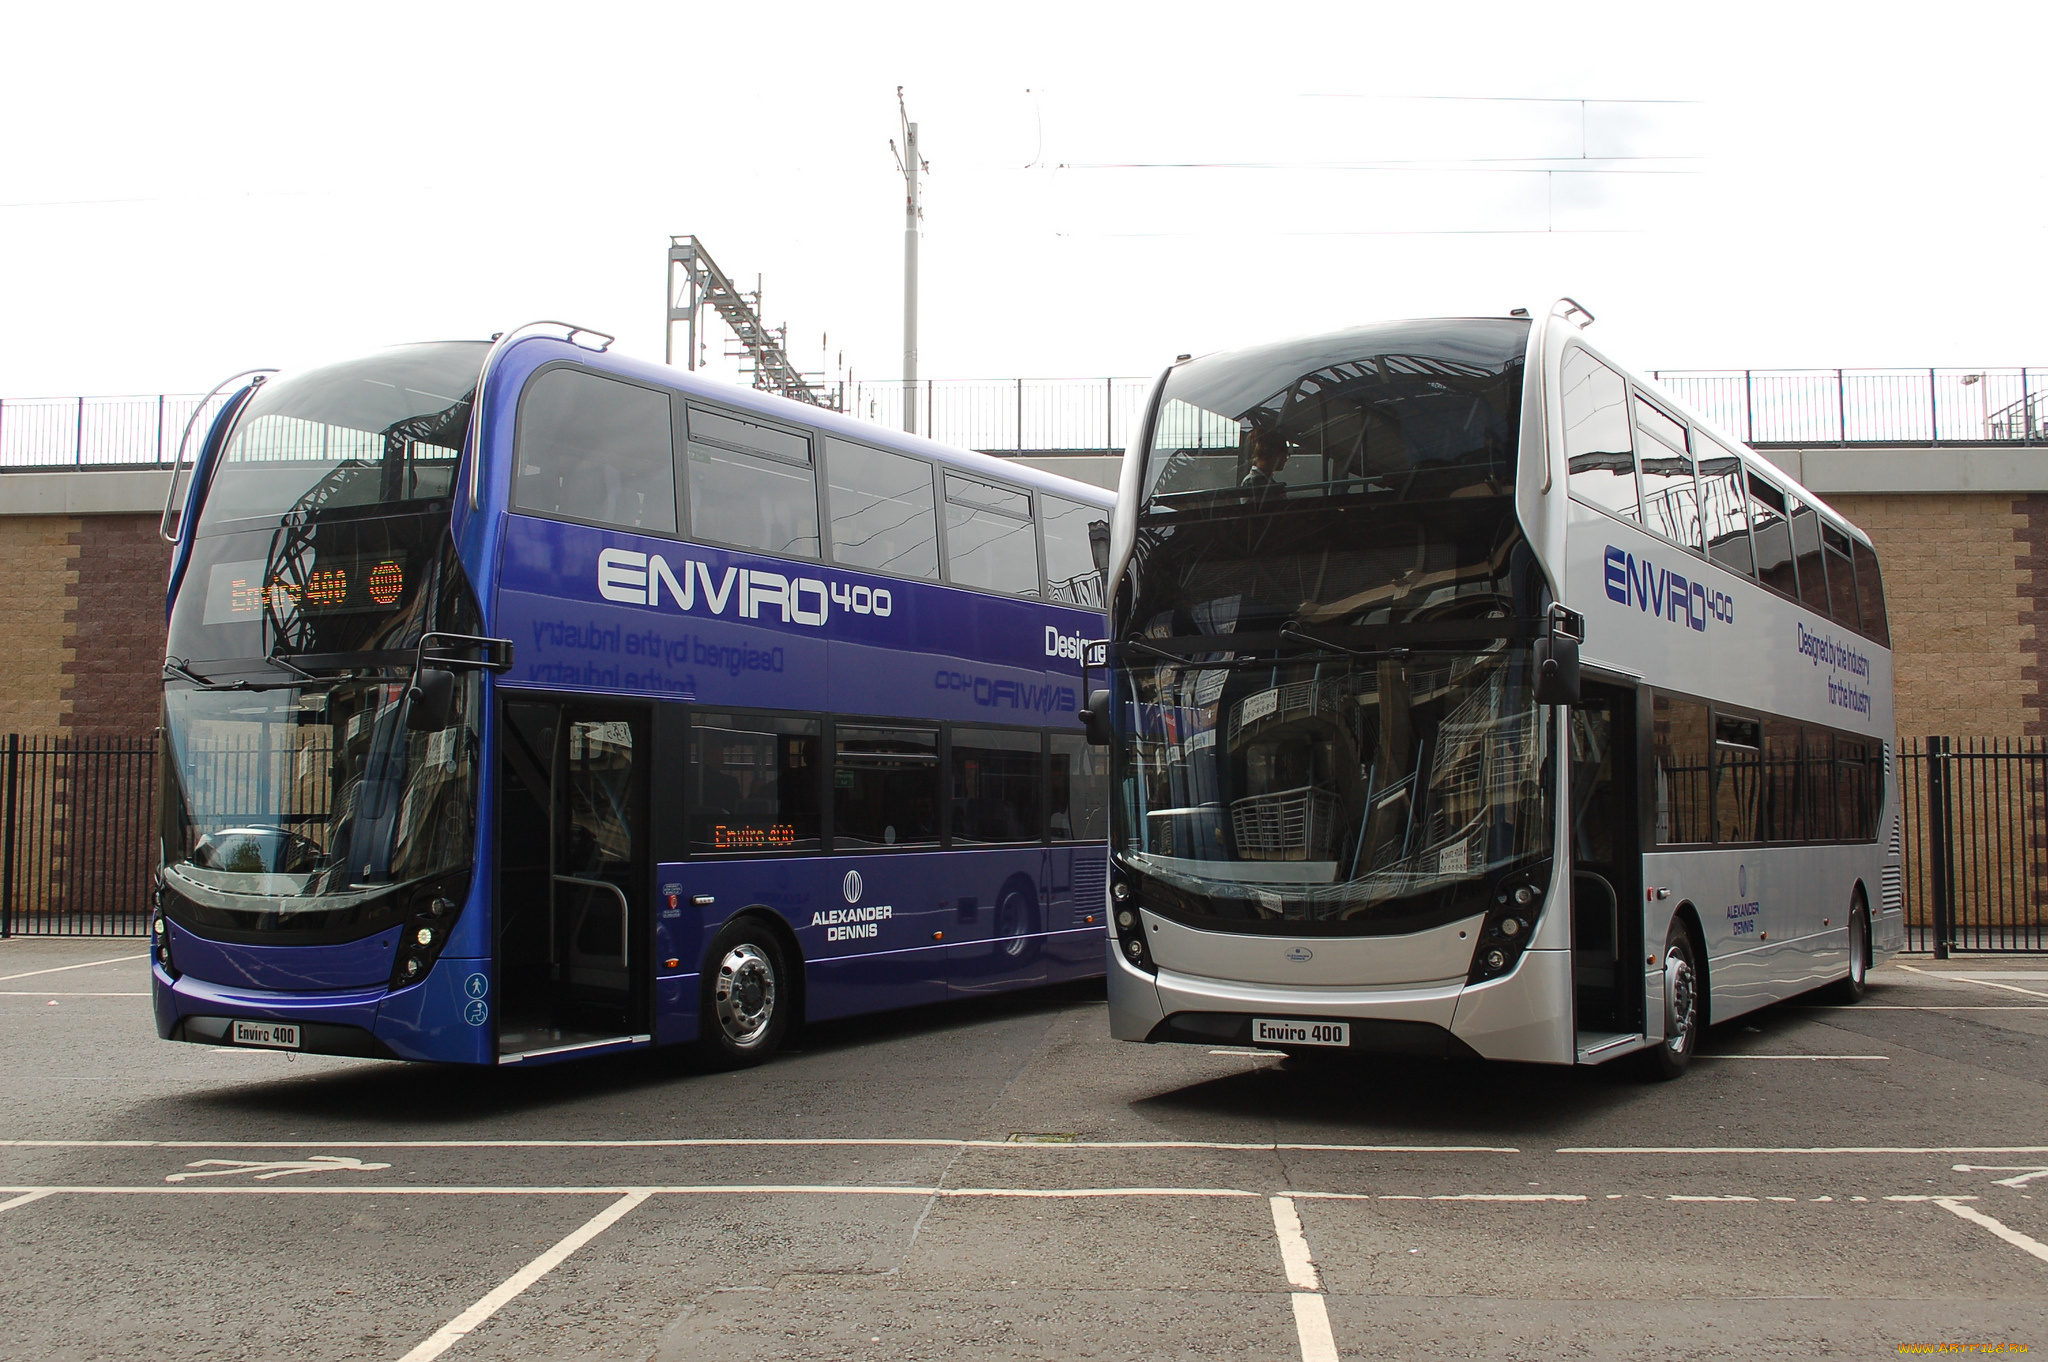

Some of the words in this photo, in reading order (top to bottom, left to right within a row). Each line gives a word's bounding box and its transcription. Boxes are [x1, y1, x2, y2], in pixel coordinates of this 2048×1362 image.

[1045, 625, 1106, 668] Designe
[1797, 622, 1828, 667] Designed
[1847, 643, 1870, 685] Industry
[1848, 682, 1871, 722] Industry
[716, 825, 765, 848] Enviro
[811, 905, 892, 926] ALEXANDER
[1726, 901, 1760, 919] ALEXANDER
[827, 923, 878, 942] DENNIS
[1733, 919, 1754, 936] DENNIS
[238, 1024, 270, 1042] Enviro
[273, 1027, 294, 1043] 400
[1259, 1022, 1306, 1041] Enviro
[1311, 1025, 1342, 1042] 400
